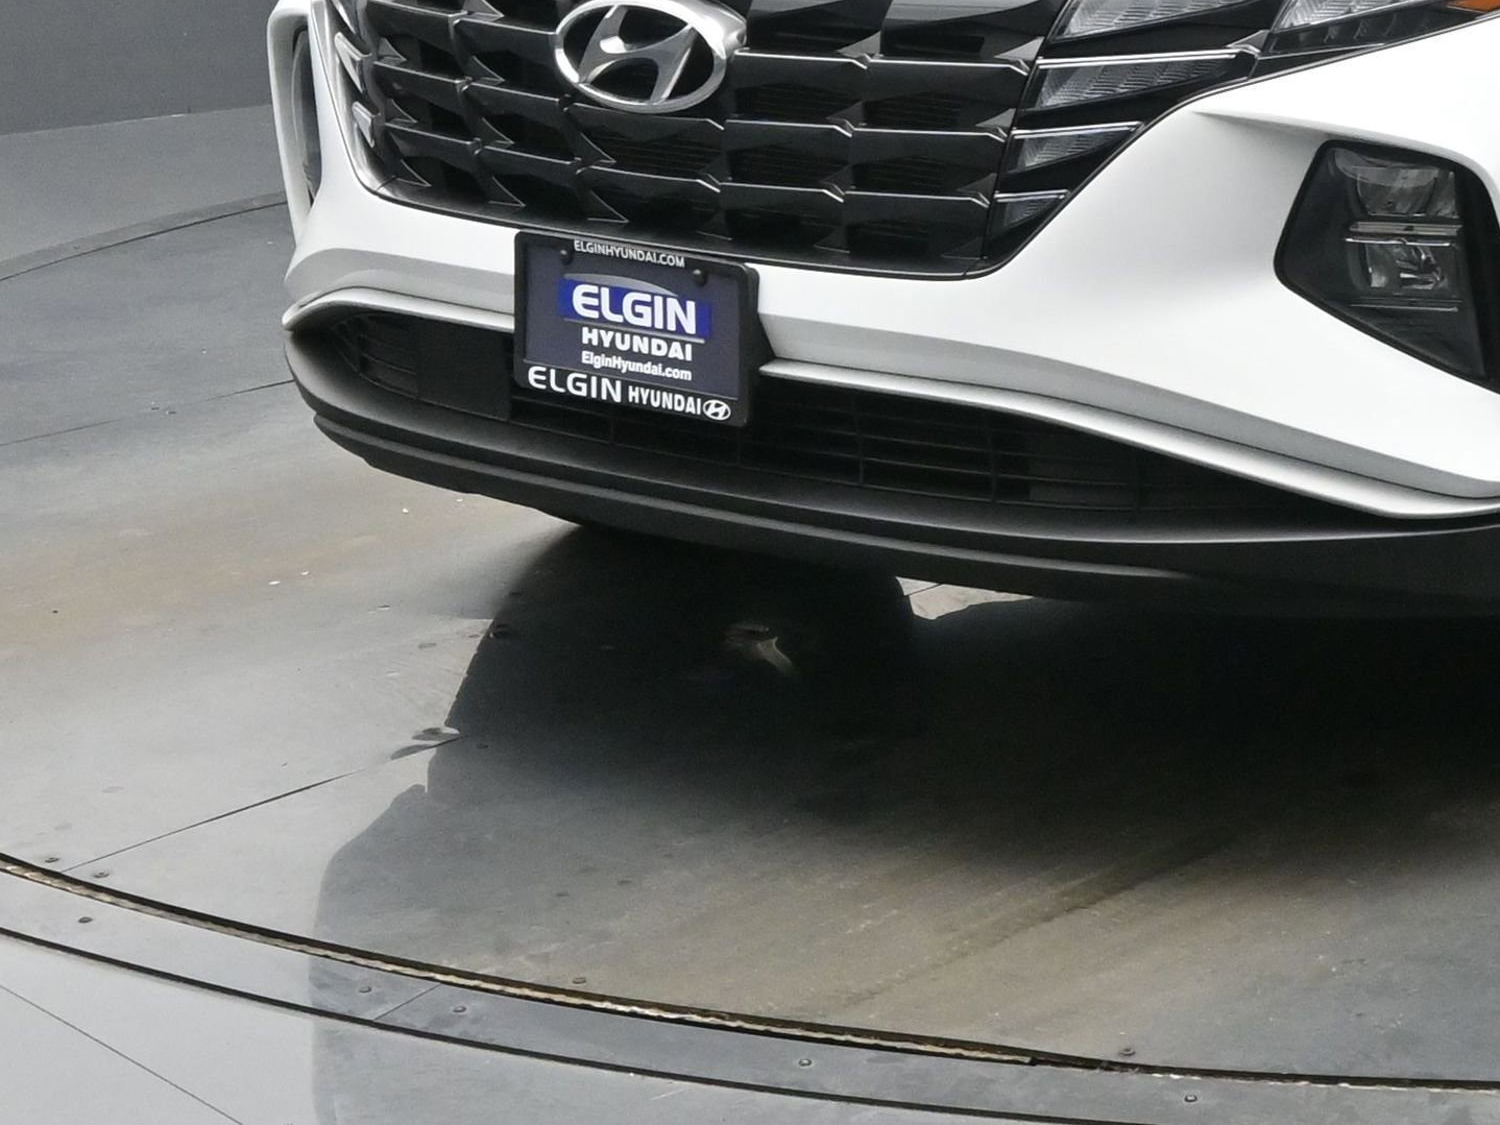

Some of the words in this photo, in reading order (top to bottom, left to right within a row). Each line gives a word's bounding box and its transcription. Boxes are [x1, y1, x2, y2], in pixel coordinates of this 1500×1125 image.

[573, 239, 685, 268] ELGINHYUNDAI.COM
[572, 283, 696, 334] ELGIN
[581, 326, 693, 361] HYUNDAI
[581, 350, 692, 381] ElginHyundai.com
[528, 365, 622, 403] ELGIN
[628, 385, 702, 416] HYUNDAI
